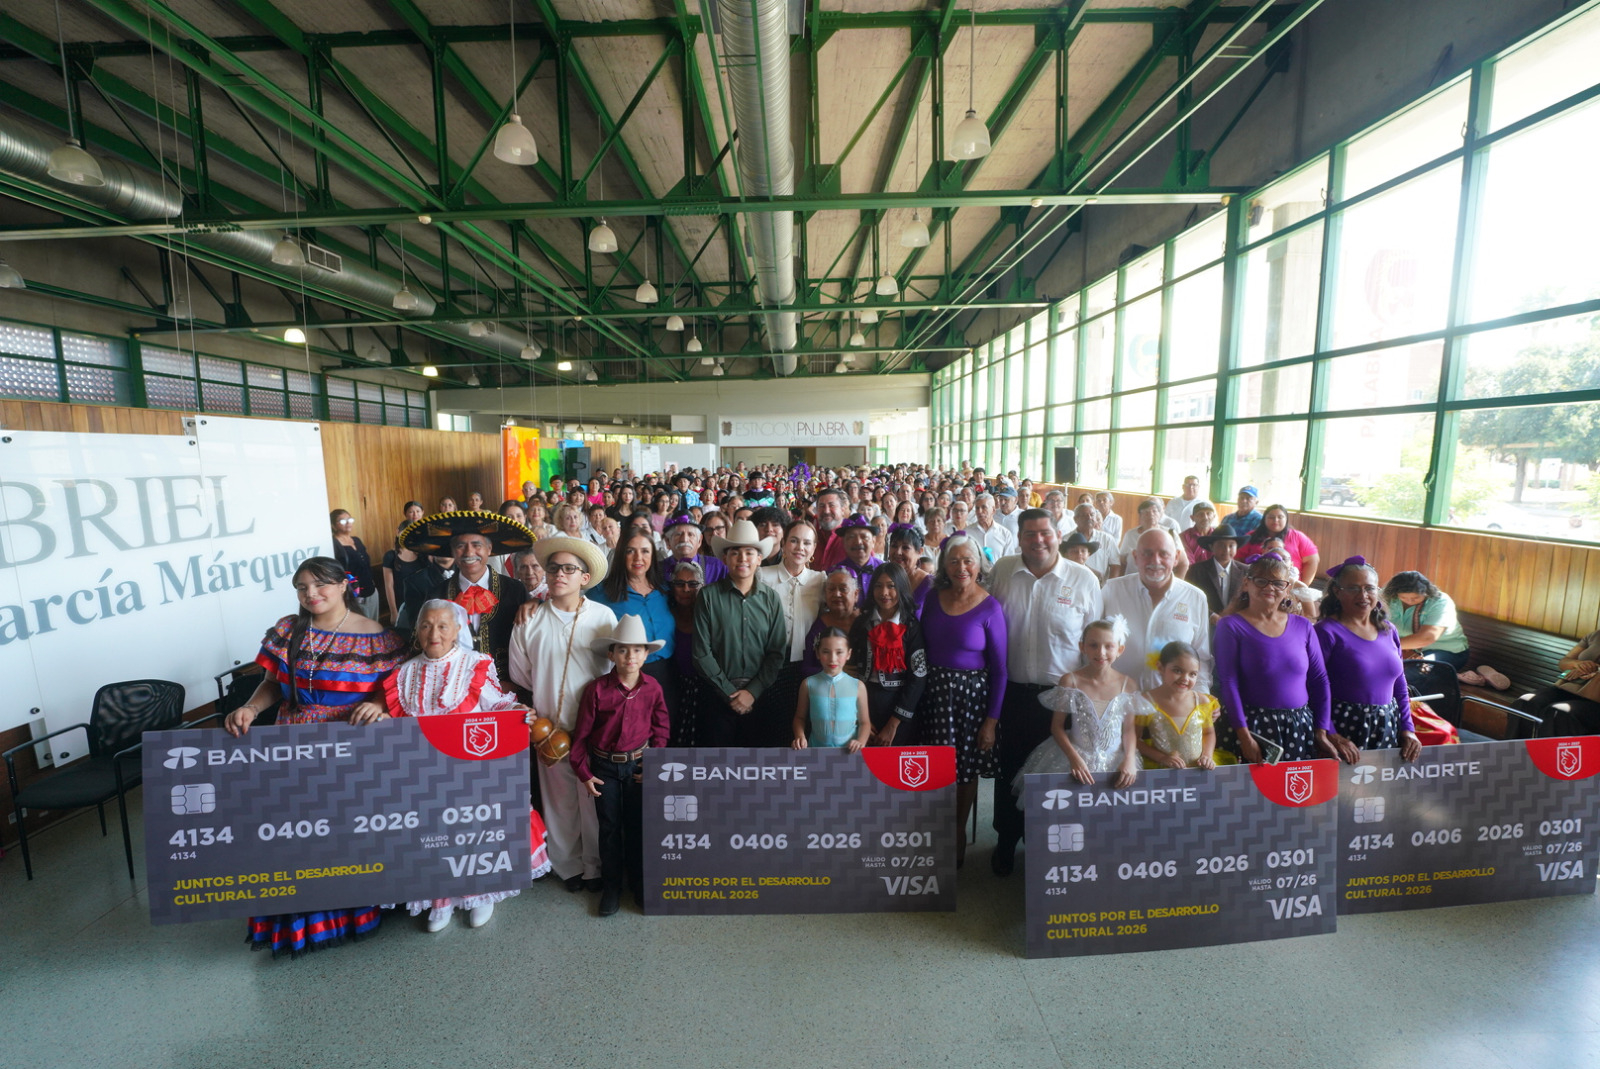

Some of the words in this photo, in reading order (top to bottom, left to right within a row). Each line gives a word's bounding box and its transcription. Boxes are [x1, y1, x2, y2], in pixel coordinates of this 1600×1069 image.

[798, 422, 850, 436] PALABRA
[207, 742, 352, 765] BANORTE
[692, 767, 807, 780] BANORTE
[1381, 762, 1480, 781] BANORTE
[1079, 788, 1196, 807] BANORTE
[169, 826, 234, 847] 4134
[258, 818, 330, 841] 0406
[353, 811, 419, 833] 2026
[442, 803, 501, 824] 0301
[1349, 833, 1394, 850] 4134
[1411, 829, 1462, 846] 0406
[1478, 823, 1524, 841] 2026
[1539, 818, 1581, 836] 0301
[420, 835, 449, 843] VÁLIDO
[455, 830, 505, 846] 07/26
[661, 834, 711, 849] 4134
[730, 834, 788, 849] 0406
[807, 833, 861, 848] 2026
[880, 832, 932, 847] 0301
[170, 851, 196, 860] 4134
[1546, 842, 1582, 854] 07/26
[442, 851, 513, 877] VISA
[891, 856, 934, 868] 07/26
[1045, 865, 1098, 883] 4134
[1118, 861, 1177, 879] 0406
[1196, 855, 1249, 875] 2026
[1267, 848, 1314, 868] 0301
[1536, 860, 1584, 881] VISA
[173, 875, 234, 891] JUNTOS
[238, 873, 270, 884] POR
[274, 871, 291, 881] EL
[295, 862, 384, 879] DESARROLLO
[662, 877, 710, 887] JUNTOS
[713, 877, 738, 886] POR
[741, 877, 755, 886] EL
[759, 877, 830, 886] DESARROLLO
[880, 876, 940, 895] VISA
[1249, 878, 1272, 886] VÁLIDO
[1276, 874, 1317, 889] 07/26
[1346, 876, 1390, 887] JUNTOS
[1392, 874, 1415, 882] POR
[1418, 872, 1430, 881] EL
[1433, 867, 1495, 880] DESARROLLO
[174, 888, 256, 905] CULTURAL
[260, 885, 296, 898] 2026
[662, 890, 726, 899] CULTURAL
[729, 890, 759, 899] 2026
[1346, 888, 1402, 899] CULTURAL
[1406, 886, 1432, 896] 2026
[1046, 913, 1096, 925] JUNTOS
[1100, 911, 1126, 922] POR
[1129, 910, 1144, 920] EL
[1147, 904, 1219, 919] DESARROLLO
[1266, 895, 1322, 920] VISA
[1047, 926, 1114, 939] CULTURAL
[1117, 925, 1147, 935] 2026
